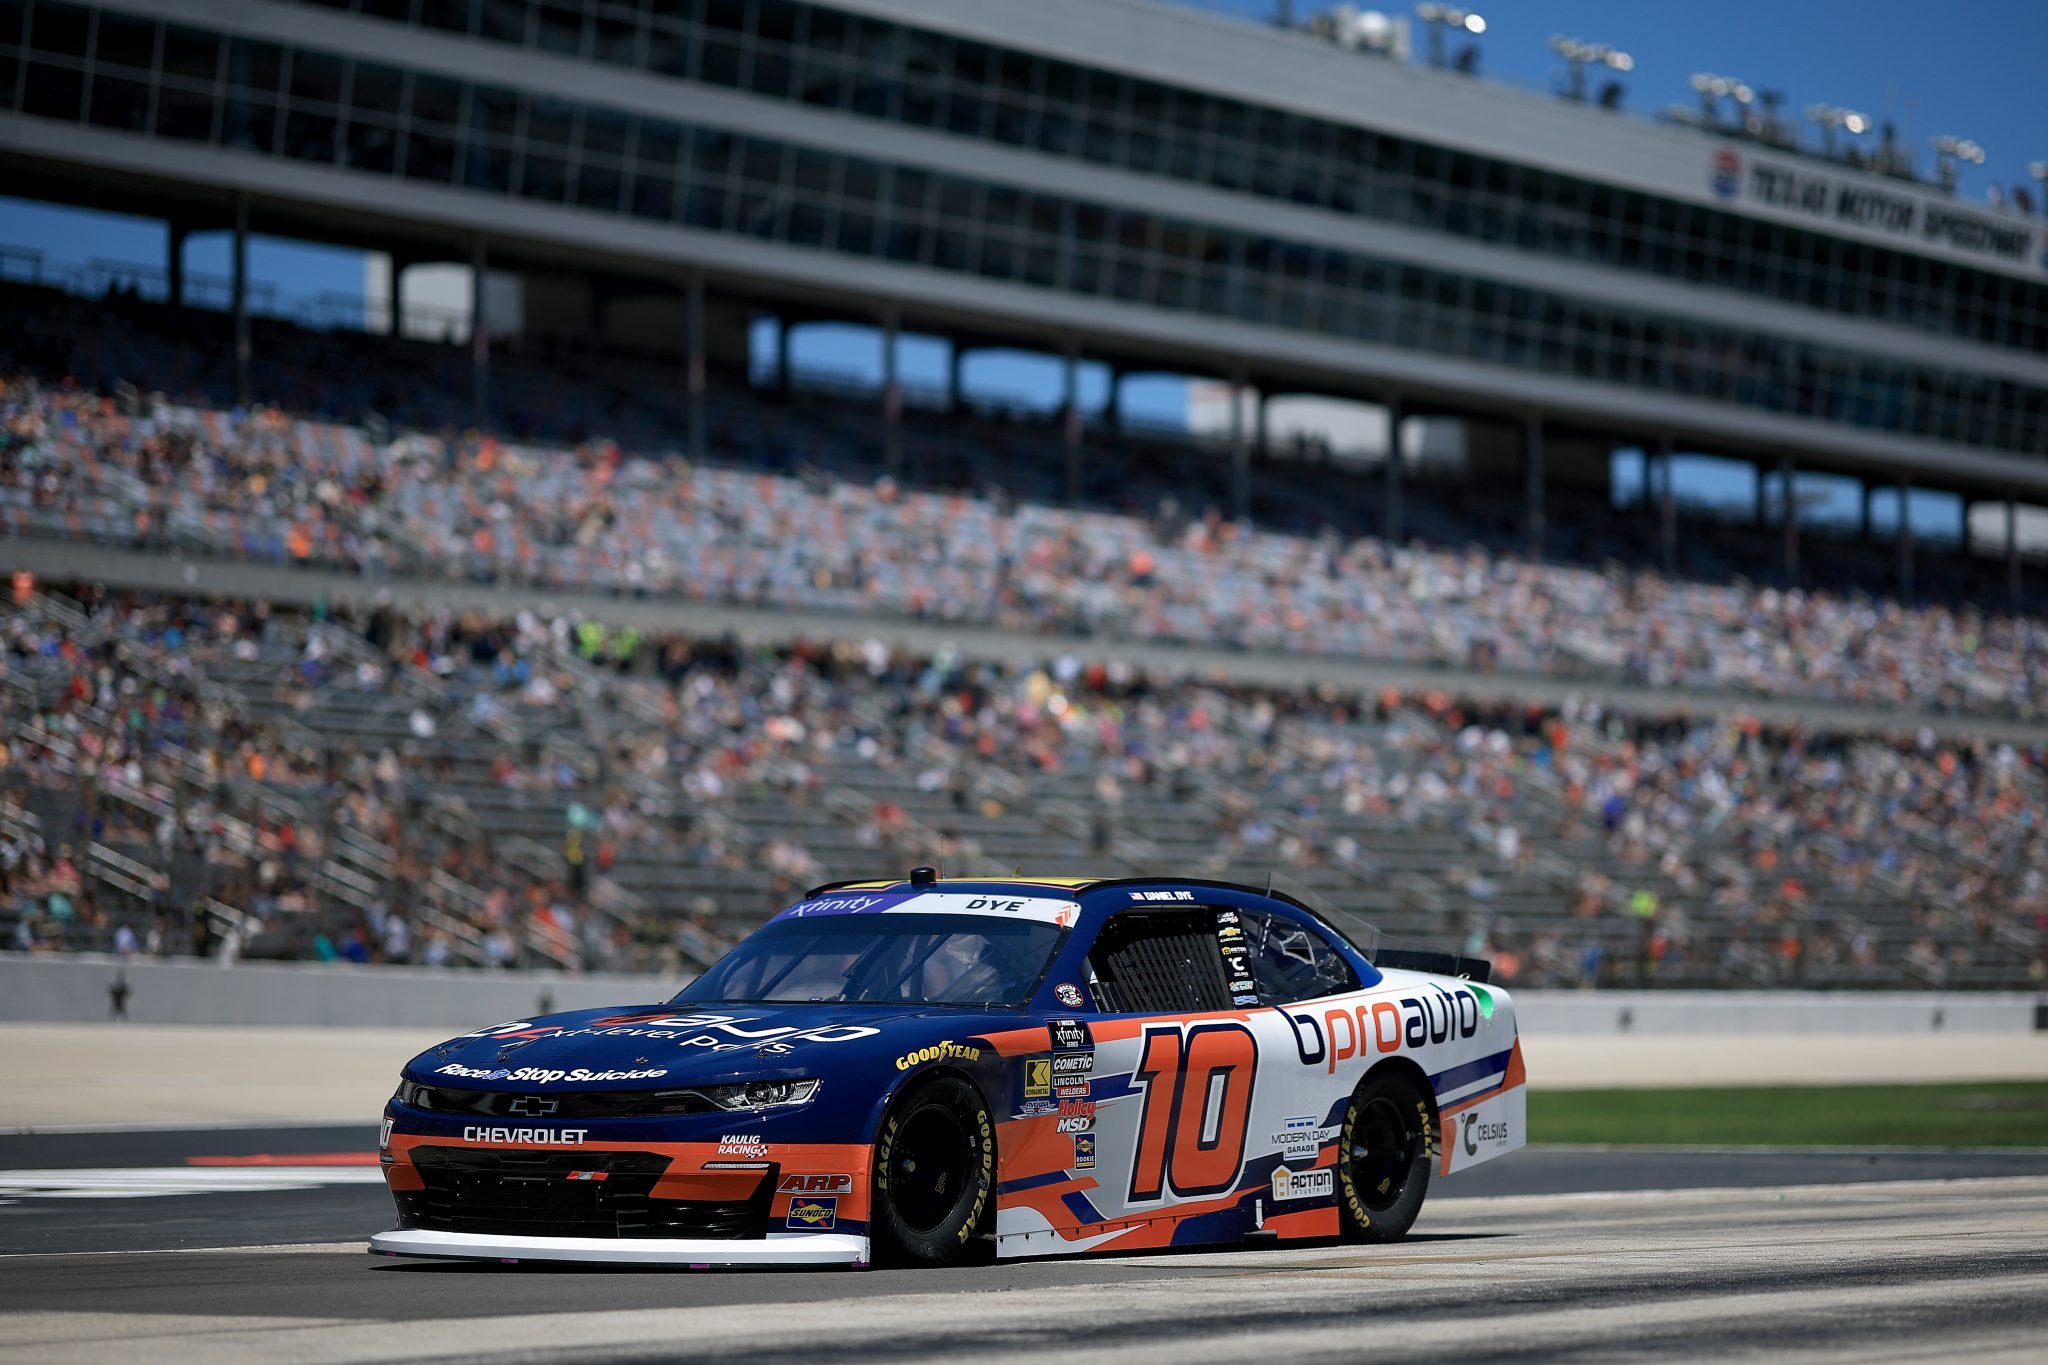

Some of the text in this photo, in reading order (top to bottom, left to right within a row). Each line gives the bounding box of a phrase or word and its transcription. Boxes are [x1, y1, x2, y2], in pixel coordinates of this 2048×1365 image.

[1143, 891, 1194, 901] DANIEL DYE
[789, 895, 884, 918] xfinity
[965, 898, 1025, 912] DYE
[1056, 1027, 1084, 1045] xfinity
[1275, 984, 1478, 1075] bproauto
[1053, 1056, 1093, 1071] COMETIC
[434, 1063, 487, 1079] Race
[507, 1067, 566, 1084] Stop
[564, 1068, 668, 1081] Suicide
[1054, 1076, 1084, 1086] LINCOLN
[1060, 1087, 1087, 1096] WELDERS
[1057, 1099, 1097, 1120] Holley
[1126, 1020, 1259, 1206] 10
[1056, 1118, 1090, 1133] MSD
[1416, 1100, 1433, 1161] EAGLE
[1478, 1122, 1508, 1141] CELSIUS
[464, 1126, 588, 1146] CHEVROLET
[721, 1135, 760, 1144] KAULIG
[1272, 1130, 1330, 1144] MODERN DAY
[718, 1145, 758, 1154] RACING
[878, 1115, 898, 1190] EAGLE
[1287, 1145, 1315, 1153] GARAGE
[779, 1175, 850, 1191] ARP
[1291, 1173, 1331, 1189] ACTION
[790, 1208, 833, 1218] SUNOCO
